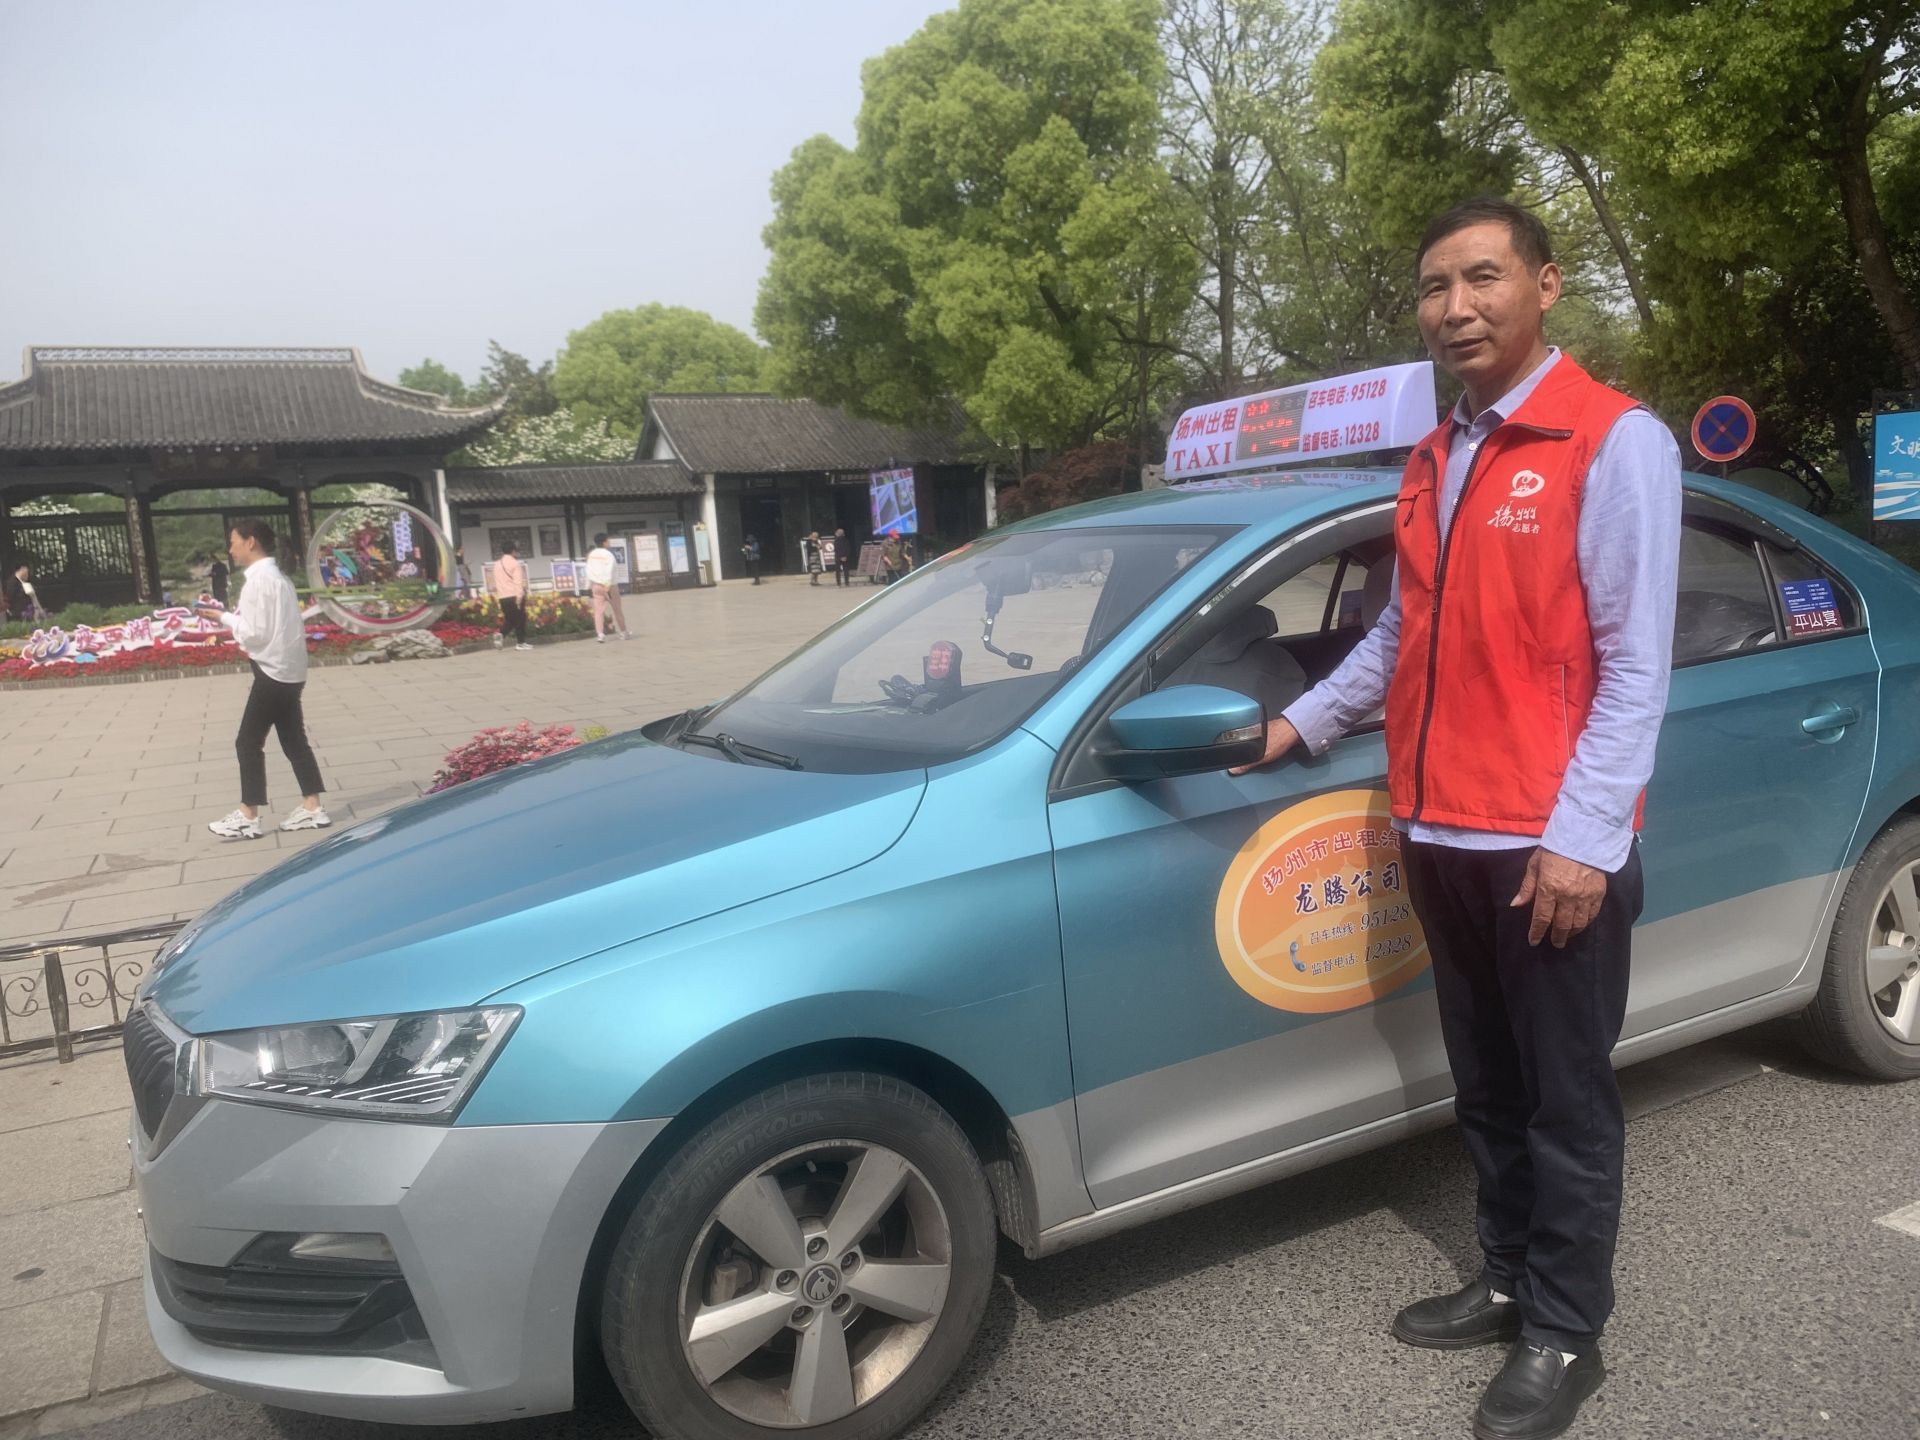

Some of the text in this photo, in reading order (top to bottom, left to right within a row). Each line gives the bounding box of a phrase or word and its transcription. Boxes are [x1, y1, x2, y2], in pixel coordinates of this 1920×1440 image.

[1175, 407, 1238, 441] 扬州出租
[1173, 442, 1232, 472] TAXI
[1511, 522, 1541, 534] 志愿者
[1295, 860, 1402, 915] 龙腾公司
